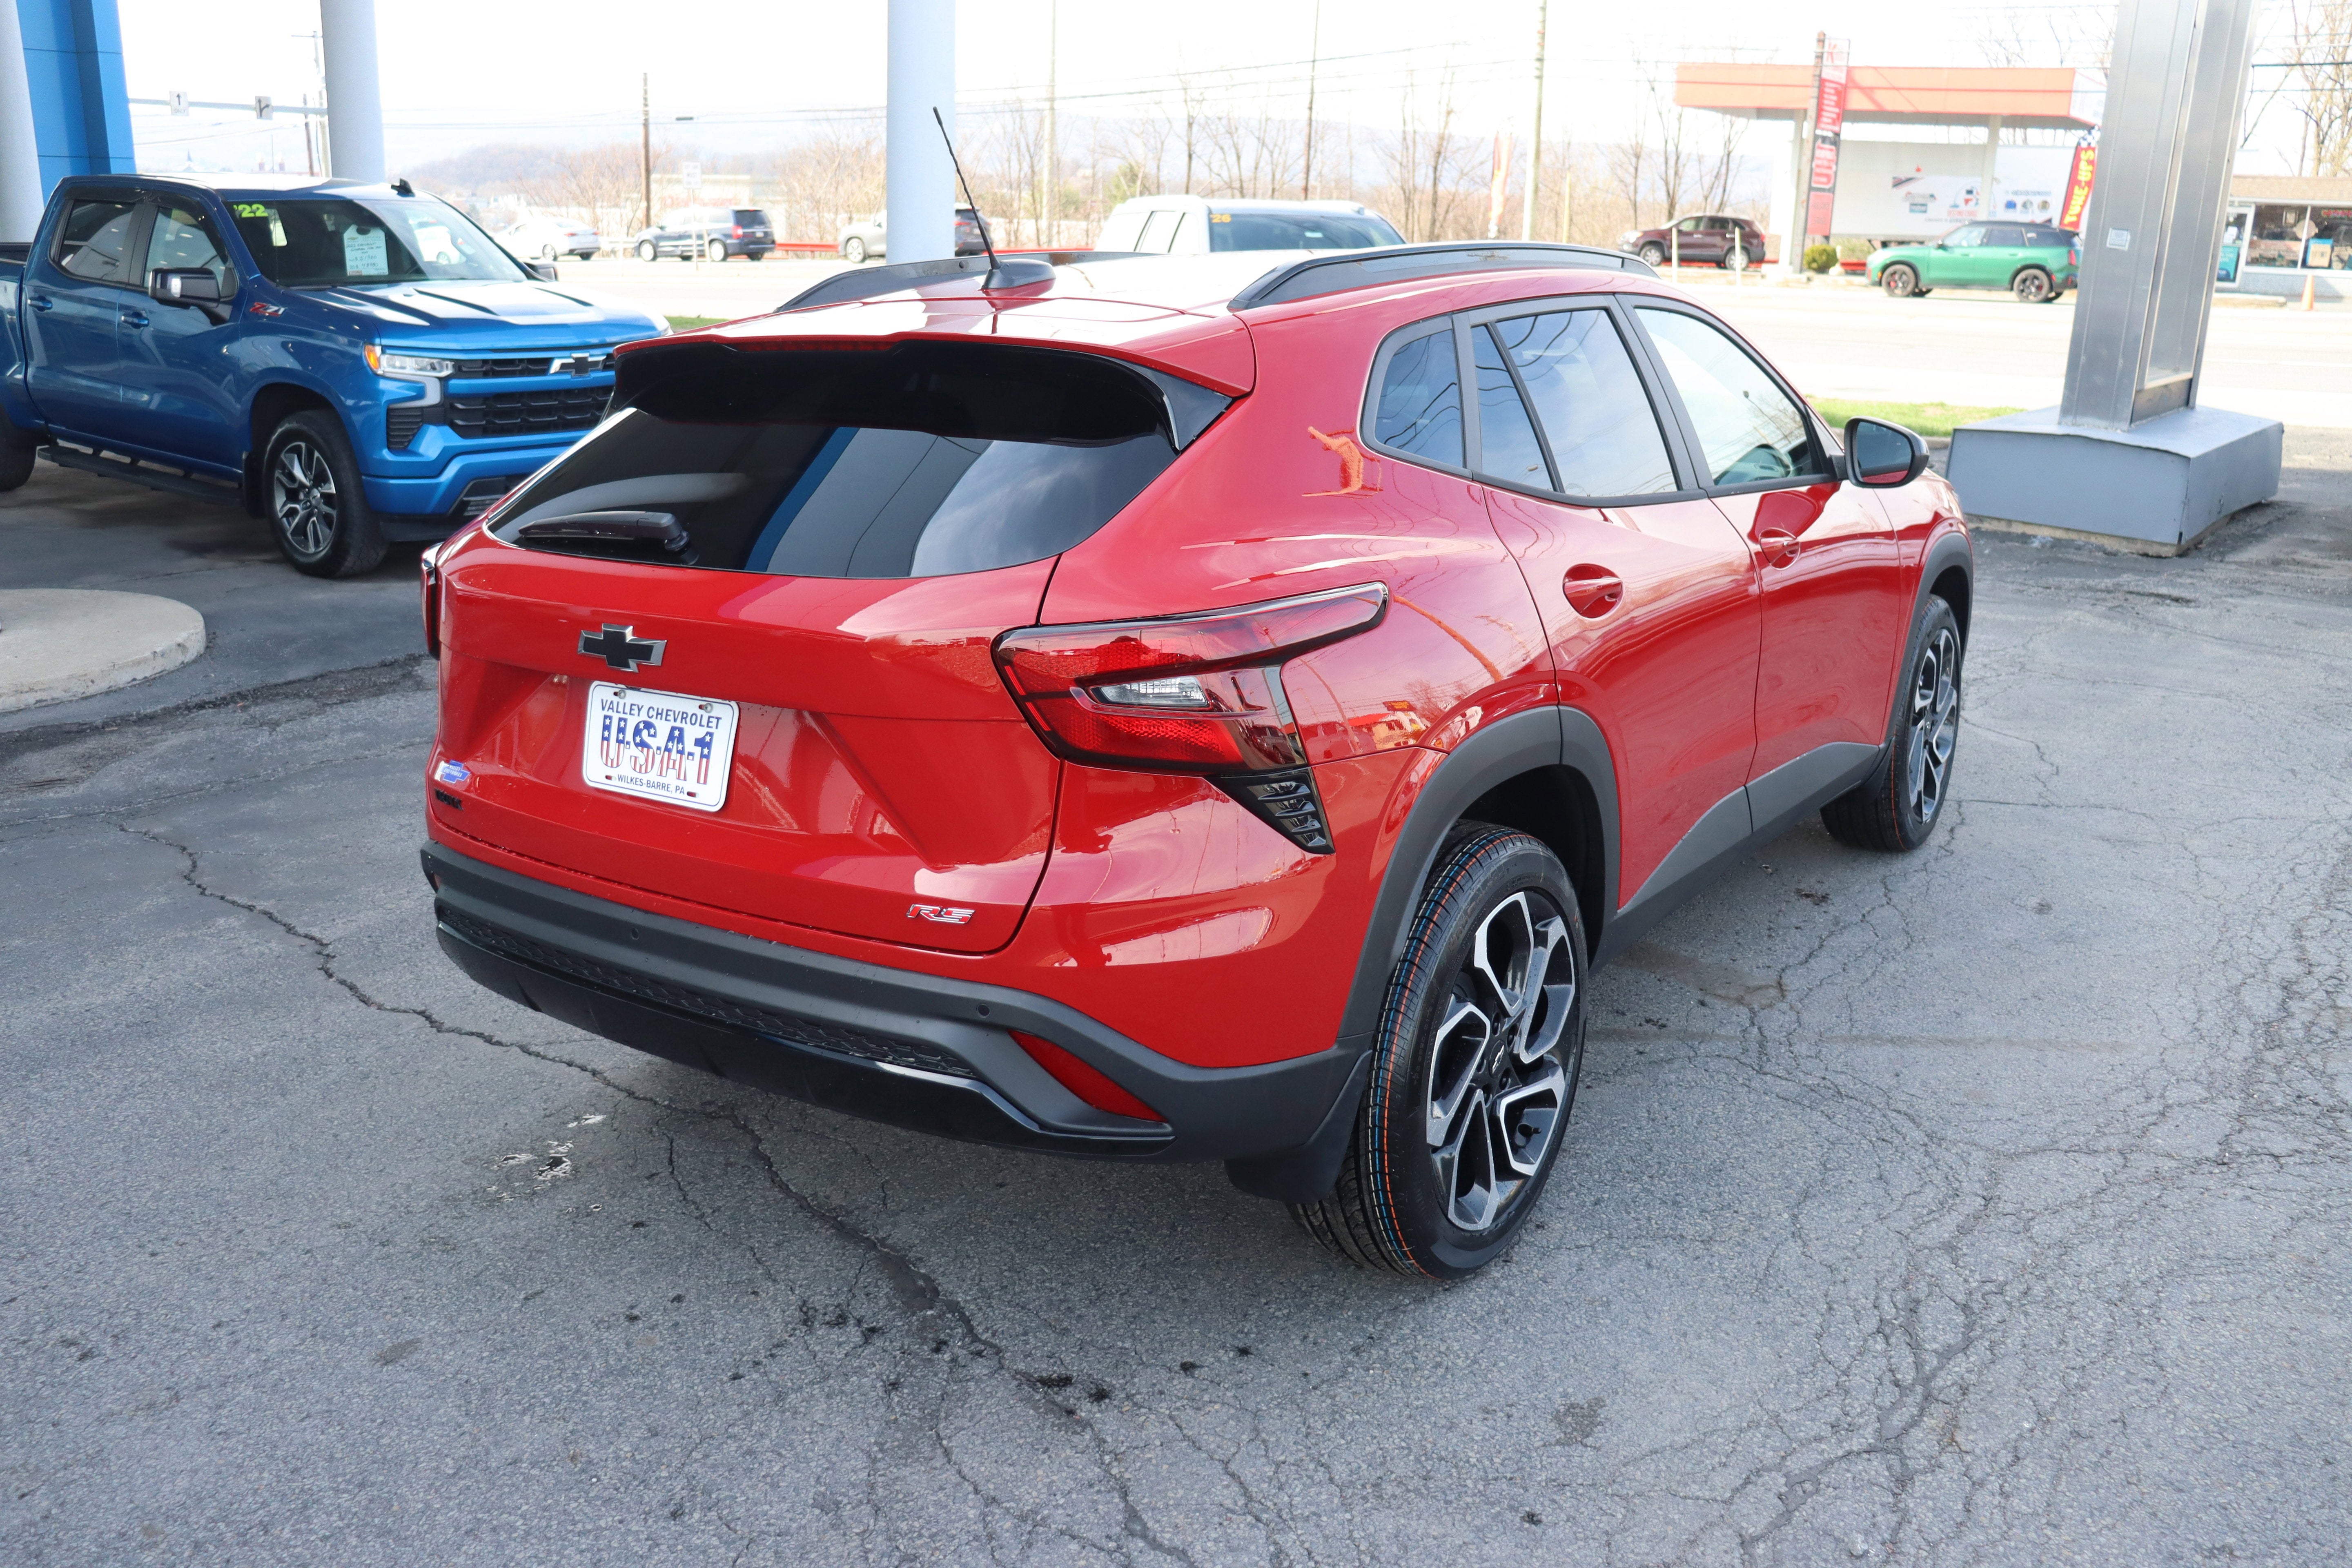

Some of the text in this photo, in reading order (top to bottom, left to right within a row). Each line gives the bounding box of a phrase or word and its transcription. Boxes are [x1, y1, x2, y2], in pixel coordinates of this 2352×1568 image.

[2063, 149, 2095, 225] TUNE-UPS
[233, 204, 269, 218] '22
[601, 698, 722, 730] VALLEY CHEVROLET
[617, 773, 685, 795] WILKES-BARRE, PA
[906, 903, 976, 924] RS
